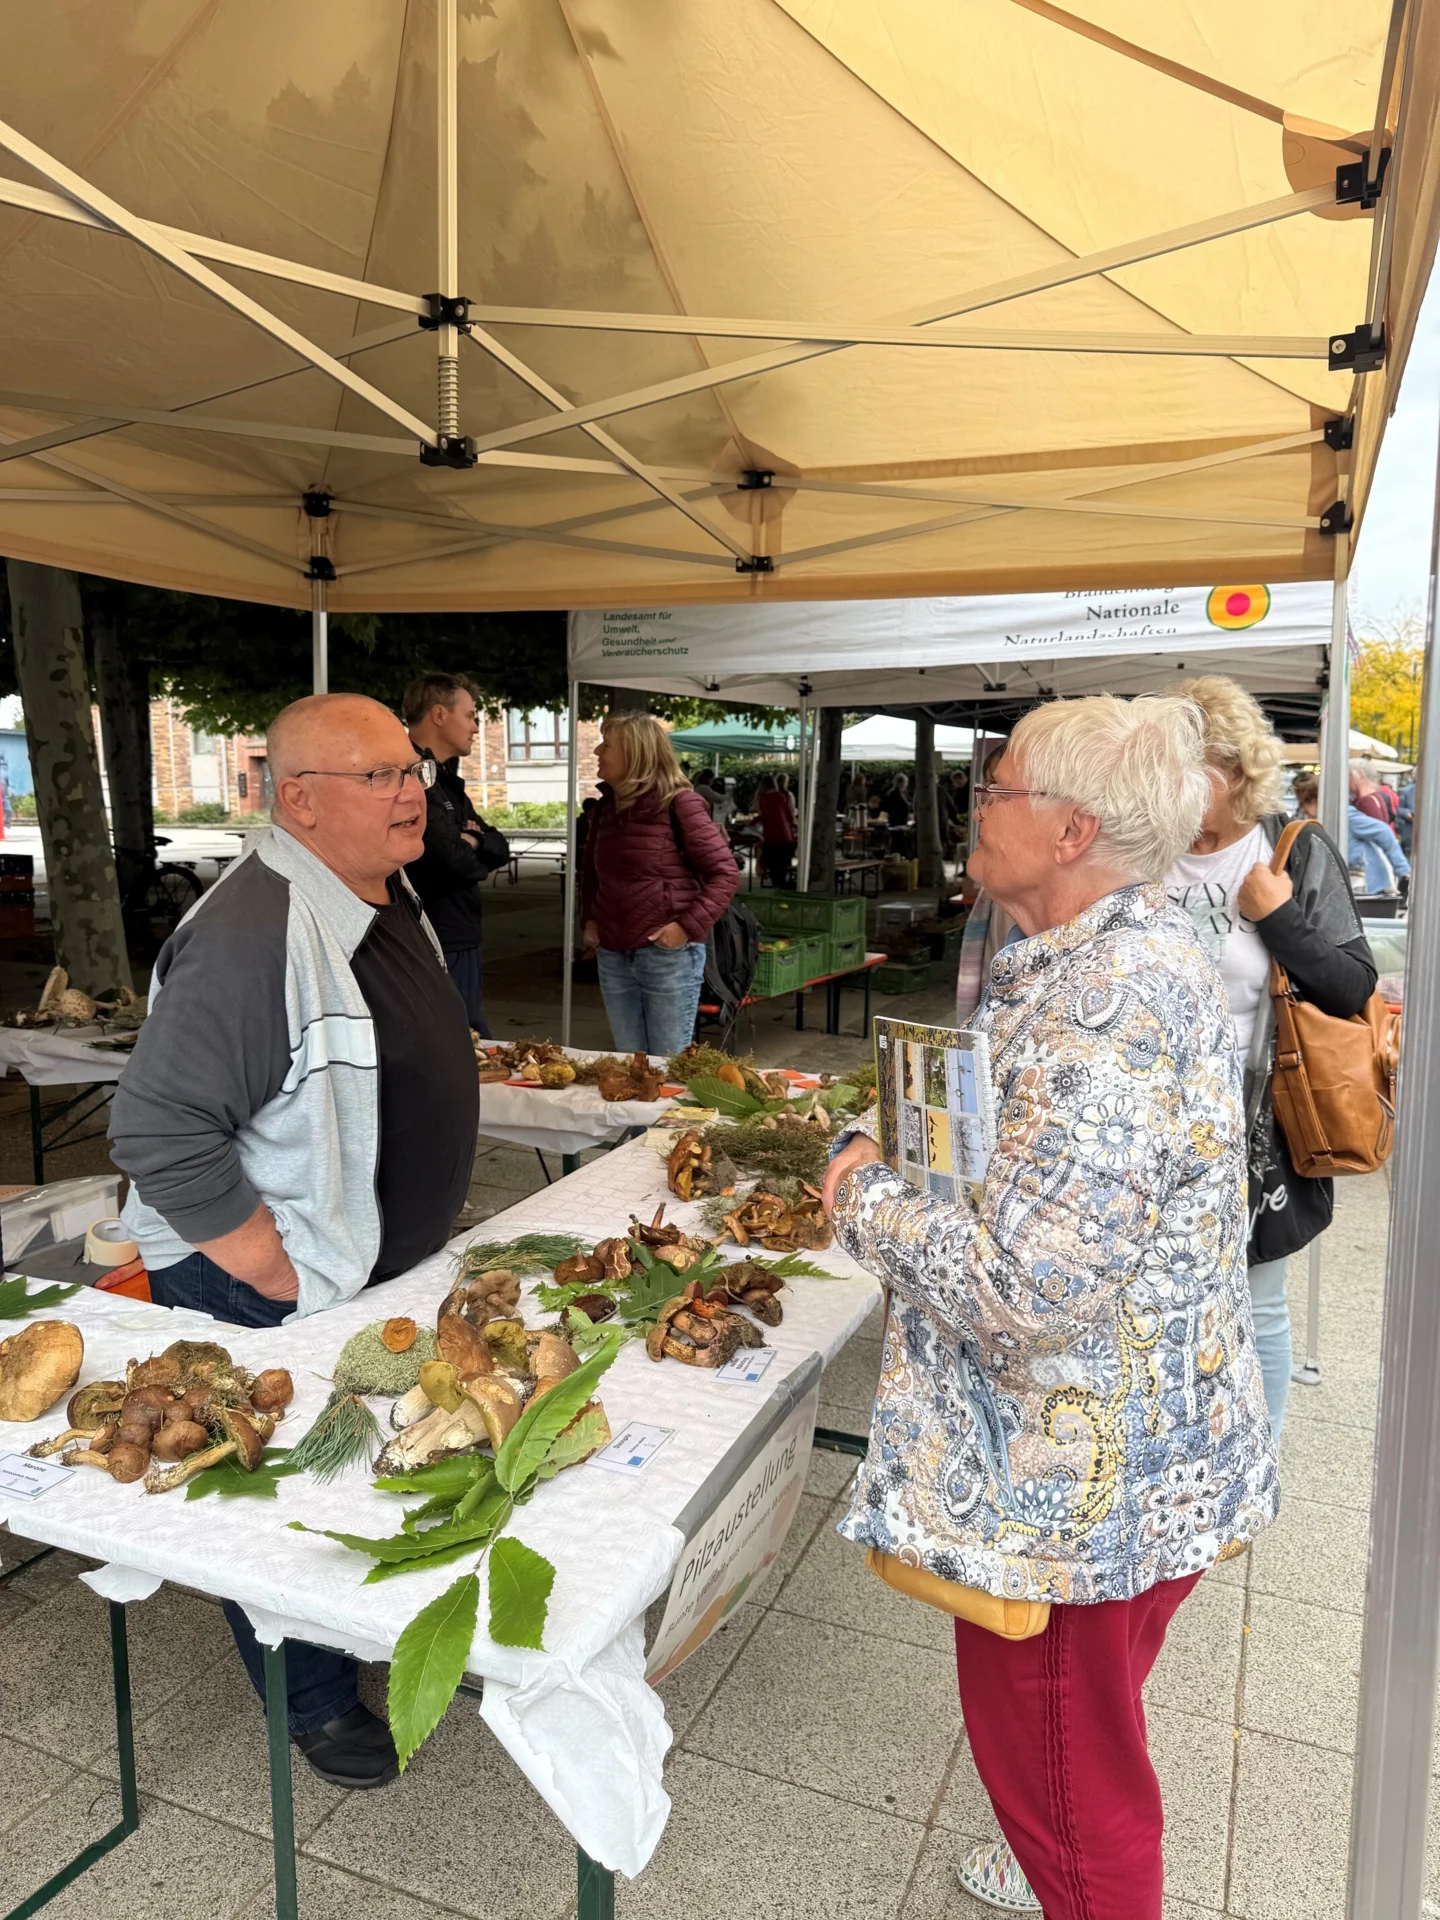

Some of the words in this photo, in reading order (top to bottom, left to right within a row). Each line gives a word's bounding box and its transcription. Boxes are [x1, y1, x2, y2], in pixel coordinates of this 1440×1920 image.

[603, 612, 657, 621] Landesamt
[658, 612, 673, 620] für
[1086, 599, 1181, 621] Nationale
[603, 625, 640, 634] Umwelt,
[1004, 624, 1177, 646] Naturlandschaften
[602, 637, 657, 646] Gesundheit
[678, 1435, 798, 1598] Pilzaustellung
